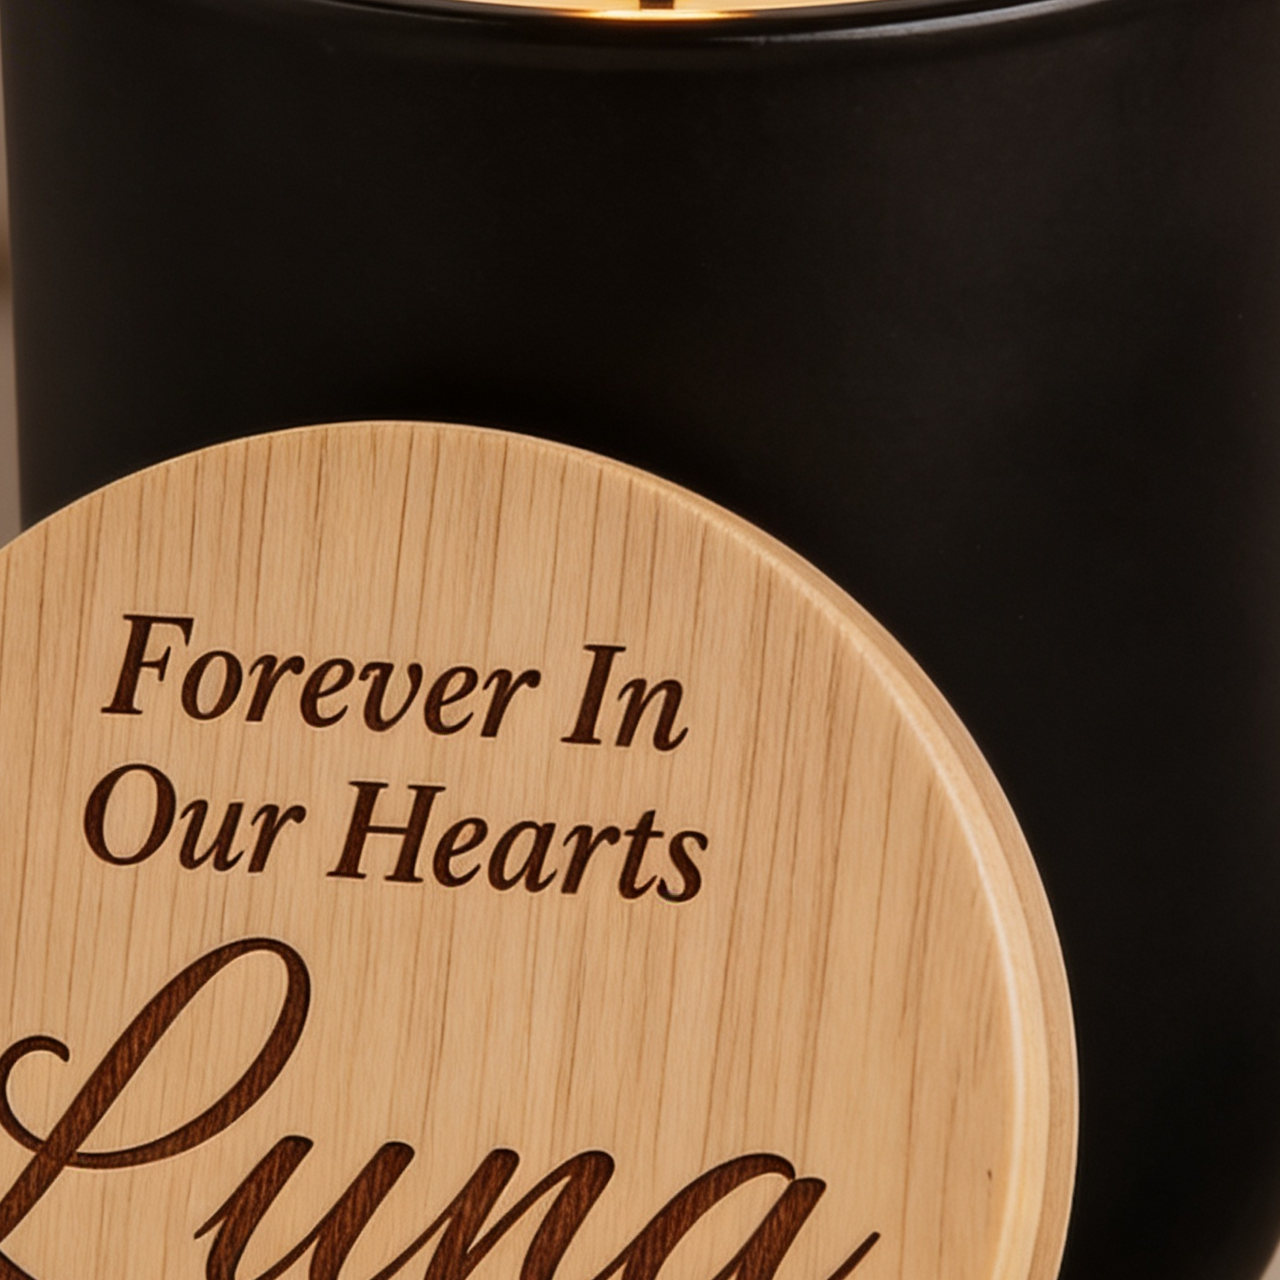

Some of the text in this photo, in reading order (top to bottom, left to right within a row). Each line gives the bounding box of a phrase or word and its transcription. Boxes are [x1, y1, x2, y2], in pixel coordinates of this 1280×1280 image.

[100, 614, 689, 752] Forever In
[83, 763, 709, 903] Our Hearts
